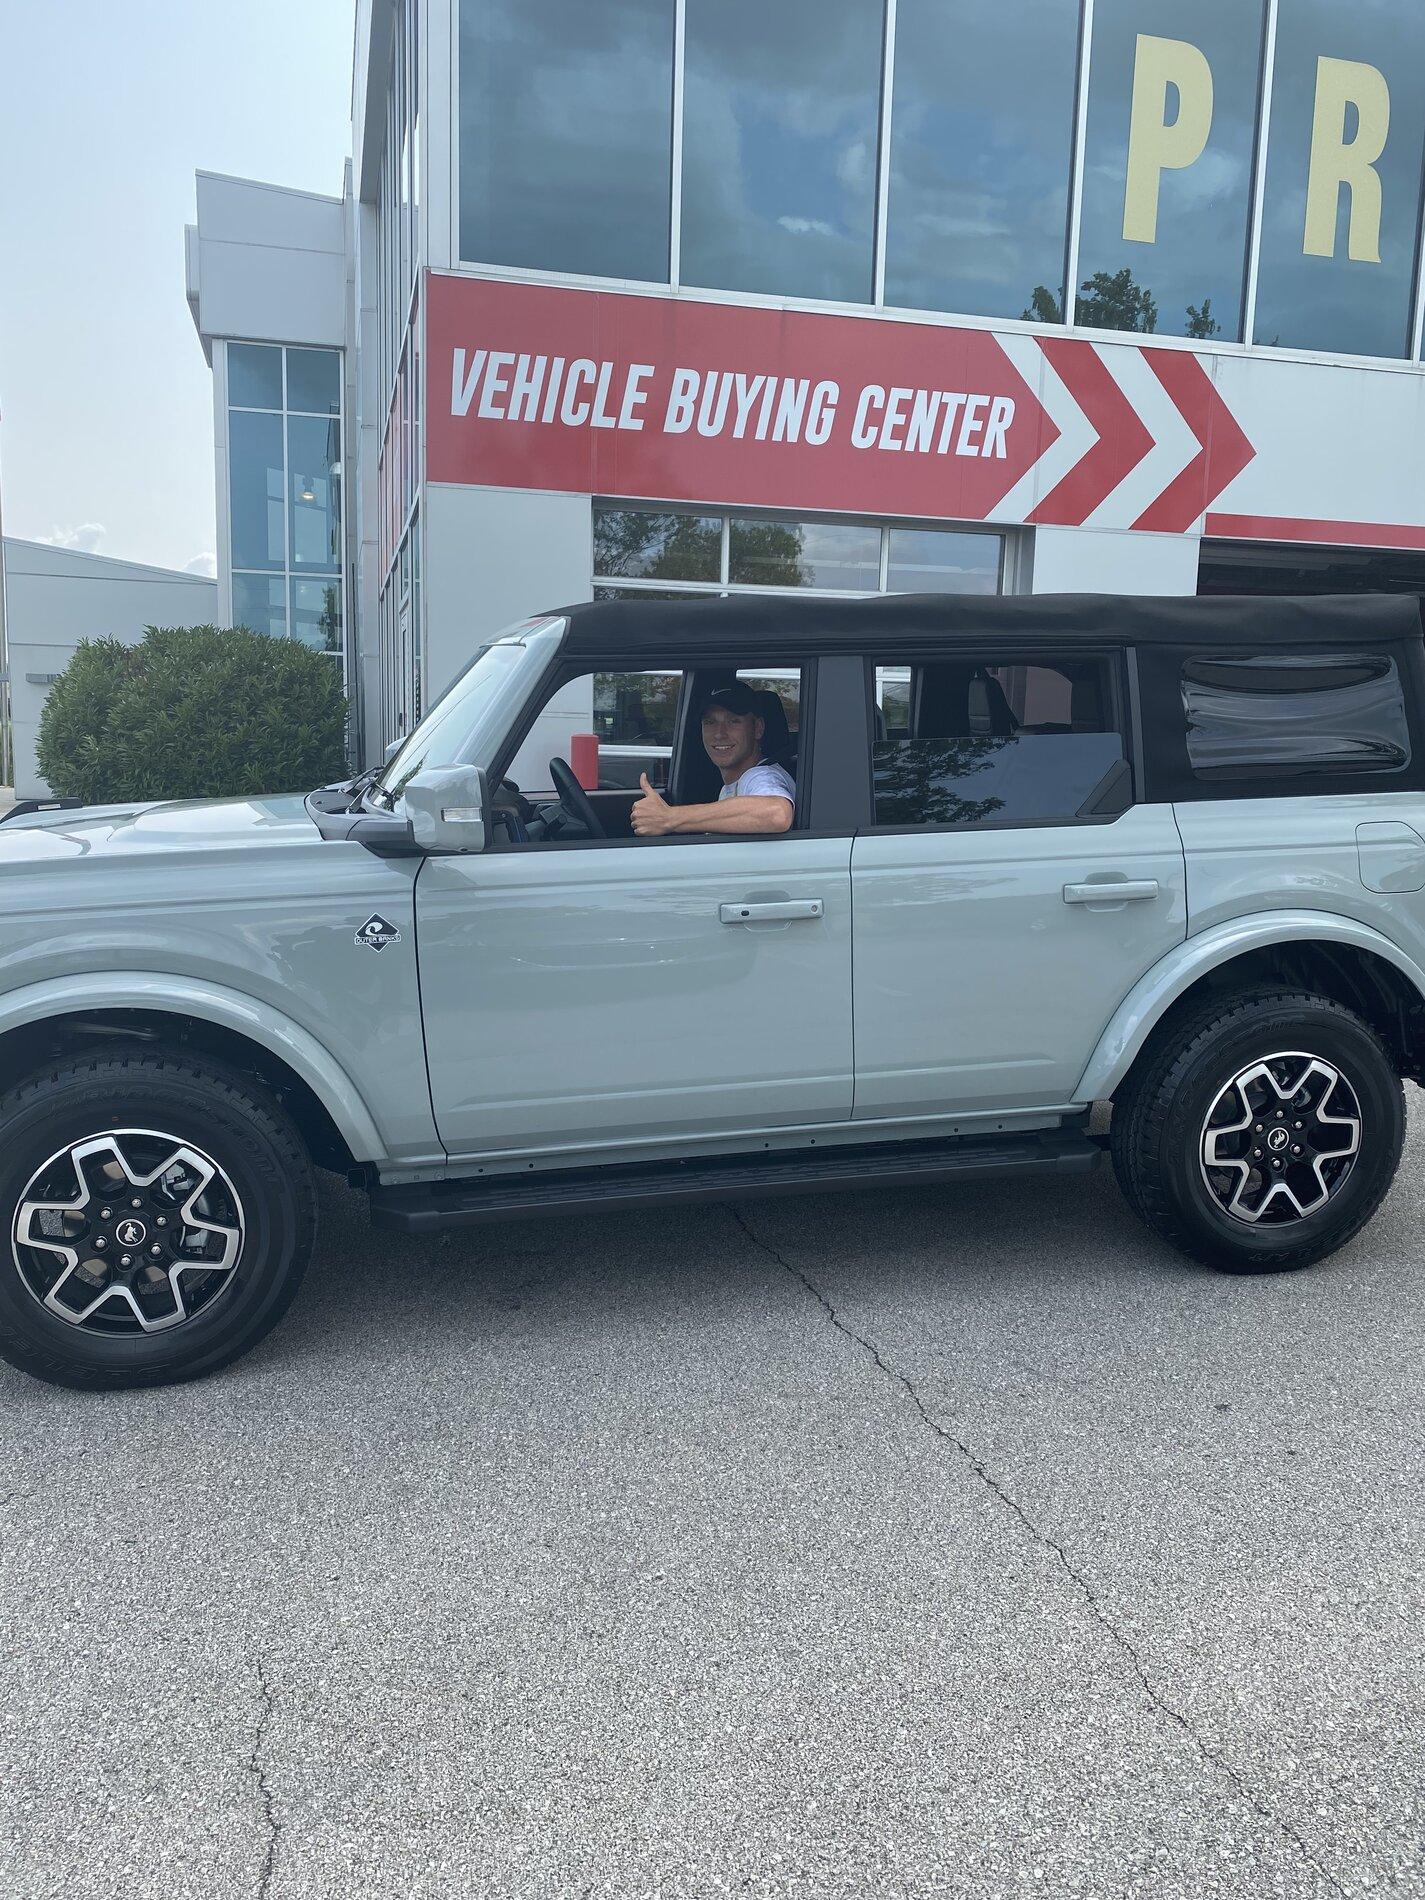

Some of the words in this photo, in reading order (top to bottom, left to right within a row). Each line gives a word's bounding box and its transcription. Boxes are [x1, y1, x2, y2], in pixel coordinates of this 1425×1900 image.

[451, 348, 655, 431] VEHICLE
[663, 368, 840, 446] BUYING
[851, 384, 1016, 459] CENTER
[356, 936, 377, 944] OUTER
